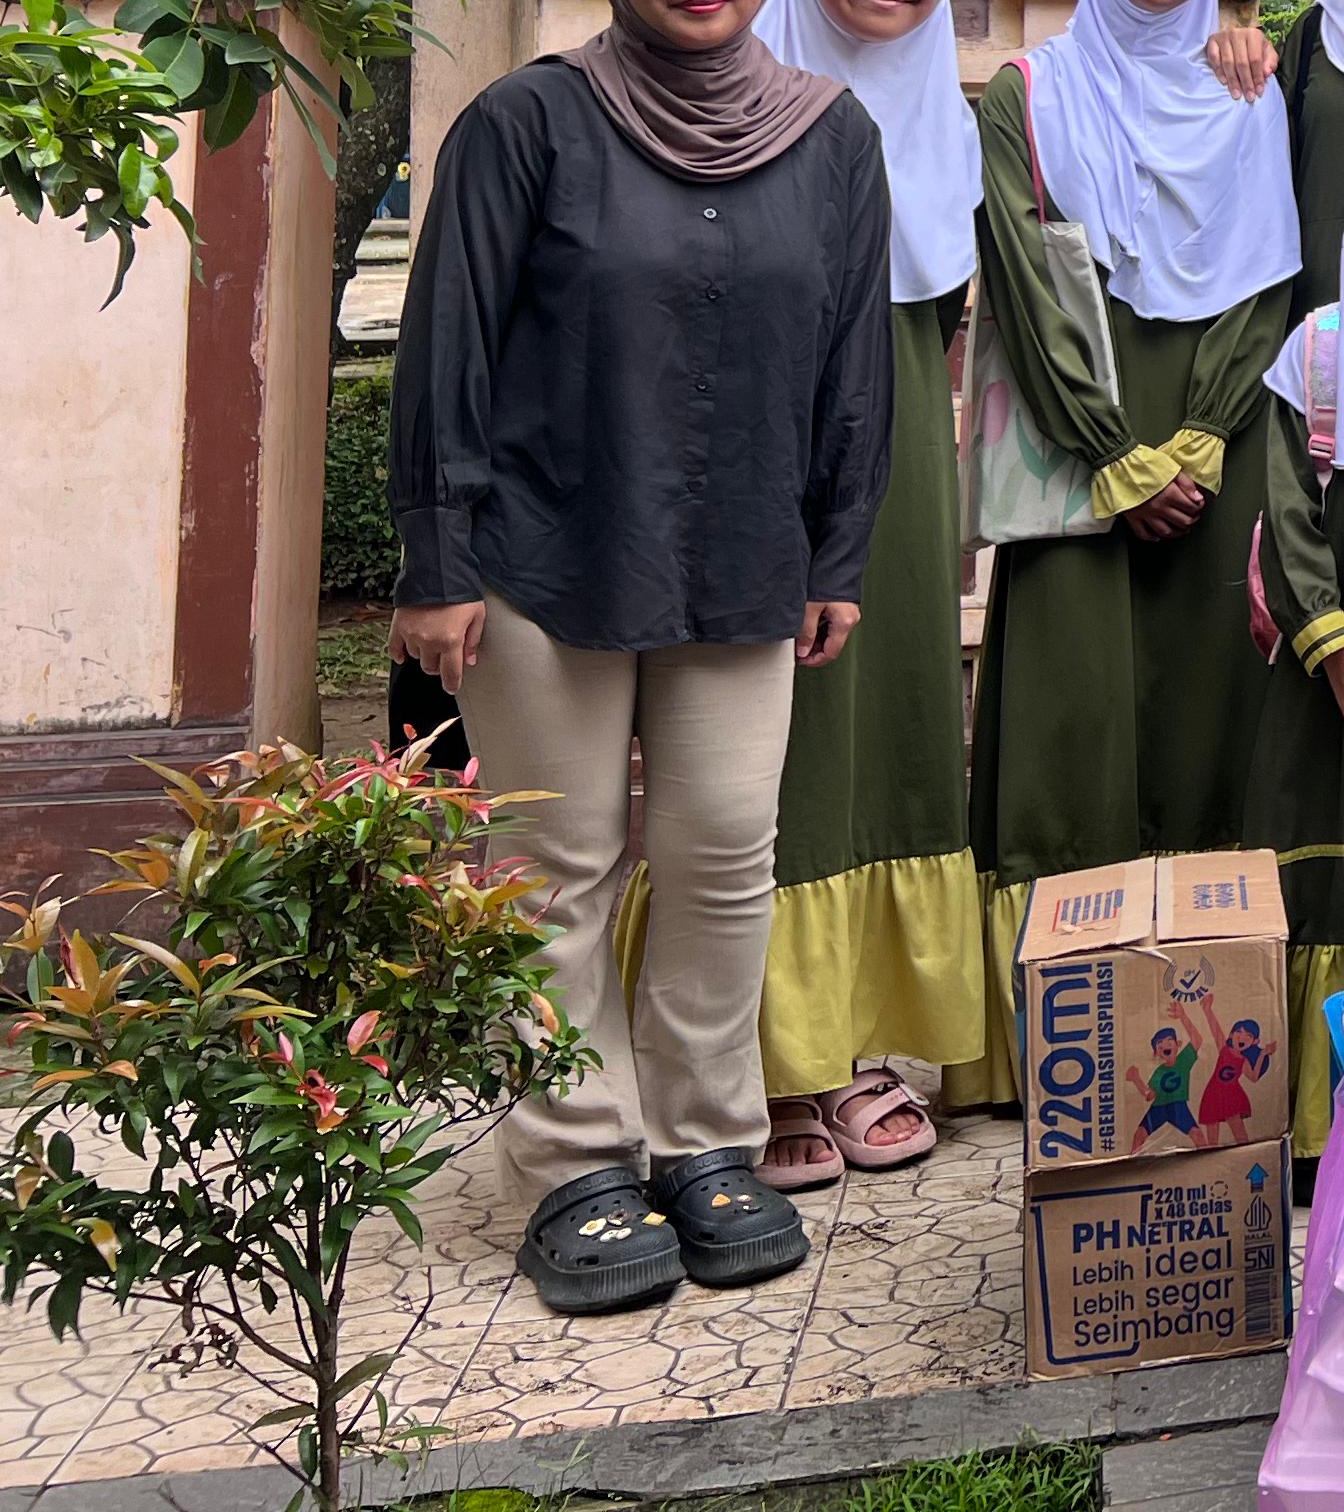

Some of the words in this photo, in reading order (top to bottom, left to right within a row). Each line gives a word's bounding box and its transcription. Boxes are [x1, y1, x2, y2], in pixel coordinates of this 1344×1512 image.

[1154, 1207, 1164, 1220] x
[1167, 1202, 1186, 1219] 48
[1189, 1199, 1232, 1217] Gelas
[1155, 1187, 1184, 1204] 220
[1187, 1185, 1206, 1201] ml
[1073, 1219, 1120, 1254] PH
[1127, 1215, 1229, 1248] NETRAL
[1073, 1260, 1134, 1286] Lebih
[1145, 1240, 1232, 1279] ideal
[1073, 1290, 1134, 1317] Lebih
[1146, 1277, 1234, 1312] segar
[1074, 1306, 1234, 1347] Seimbang
